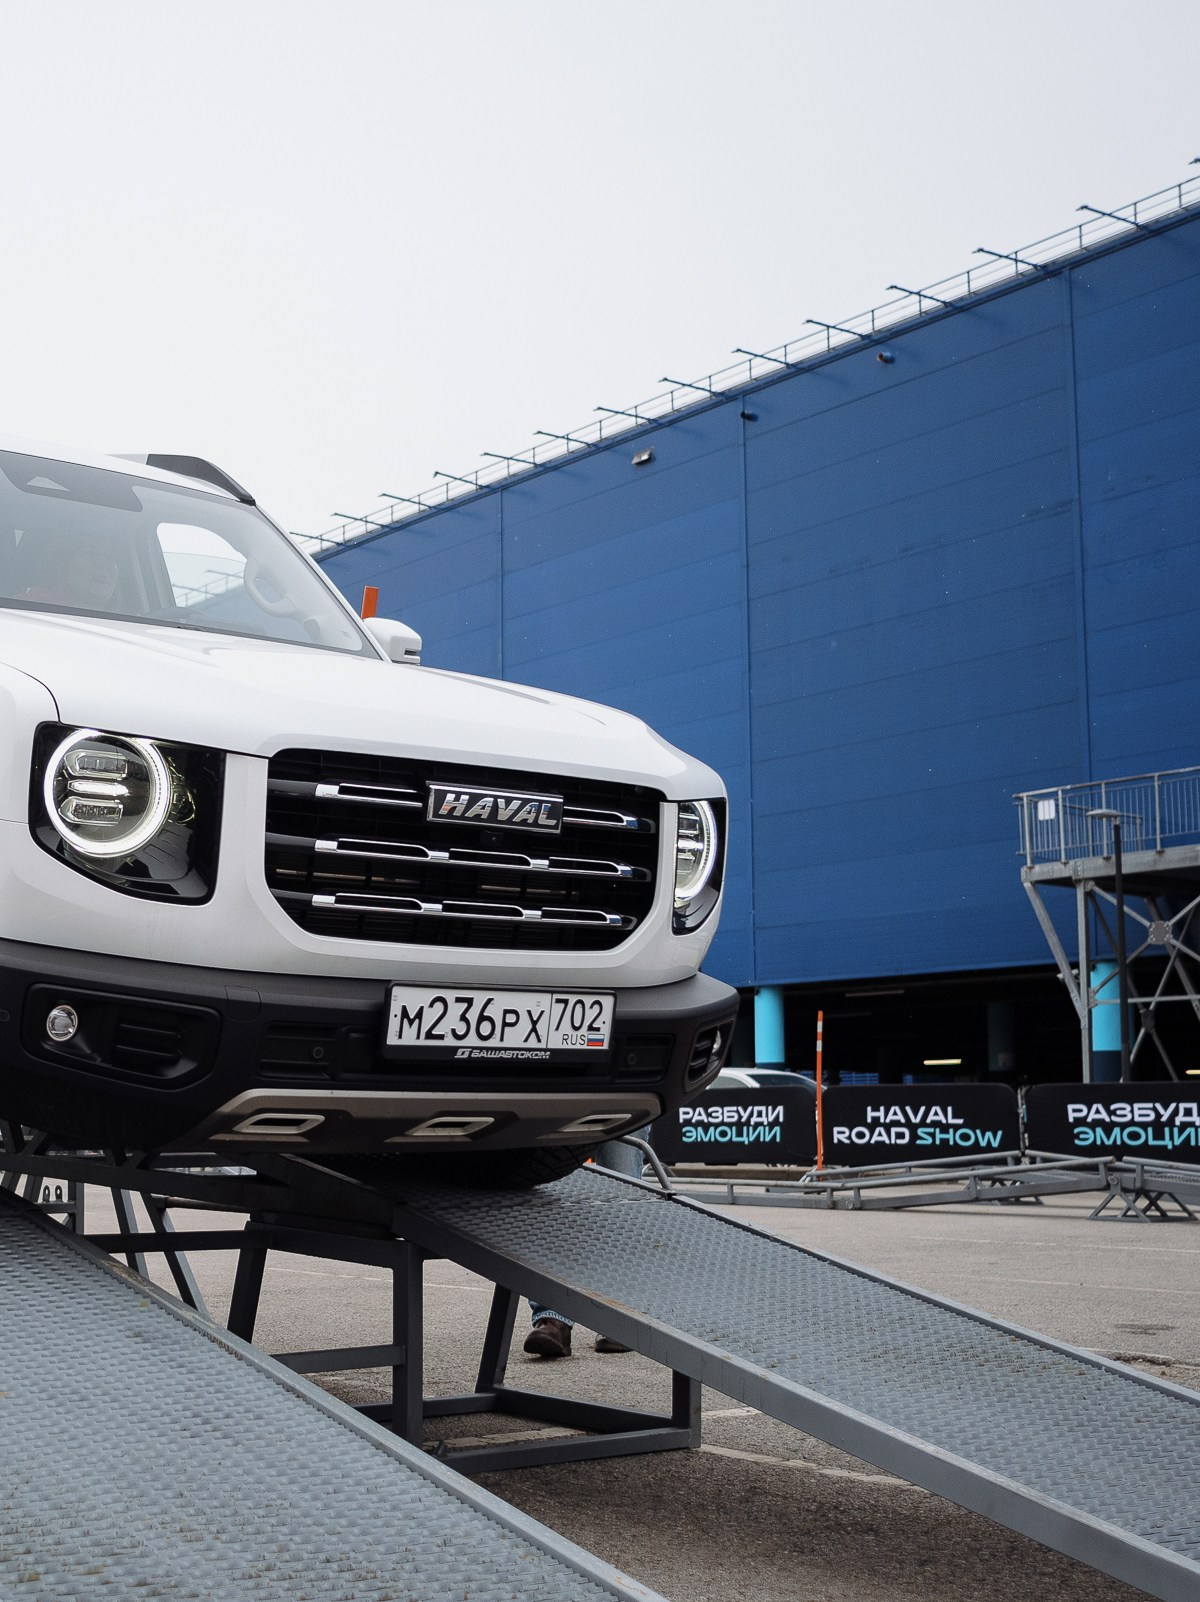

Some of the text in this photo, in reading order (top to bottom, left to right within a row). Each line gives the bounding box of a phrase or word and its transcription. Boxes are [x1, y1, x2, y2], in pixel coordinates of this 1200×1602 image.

[438, 793, 558, 826] HAVAL
[554, 998, 604, 1032] 702
[561, 1033, 587, 1046] RUS
[470, 1049, 551, 1060] БАШАВТОКОМ
[678, 1105, 784, 1125] РАЗБУДИ
[866, 1105, 964, 1124] HAVAL
[1067, 1102, 1200, 1126] РАЗБУД
[681, 1125, 781, 1145] ЭМОЦИИ
[833, 1126, 1003, 1148] ROAD SHOW
[1073, 1126, 1200, 1149] ЭМОЦИ
